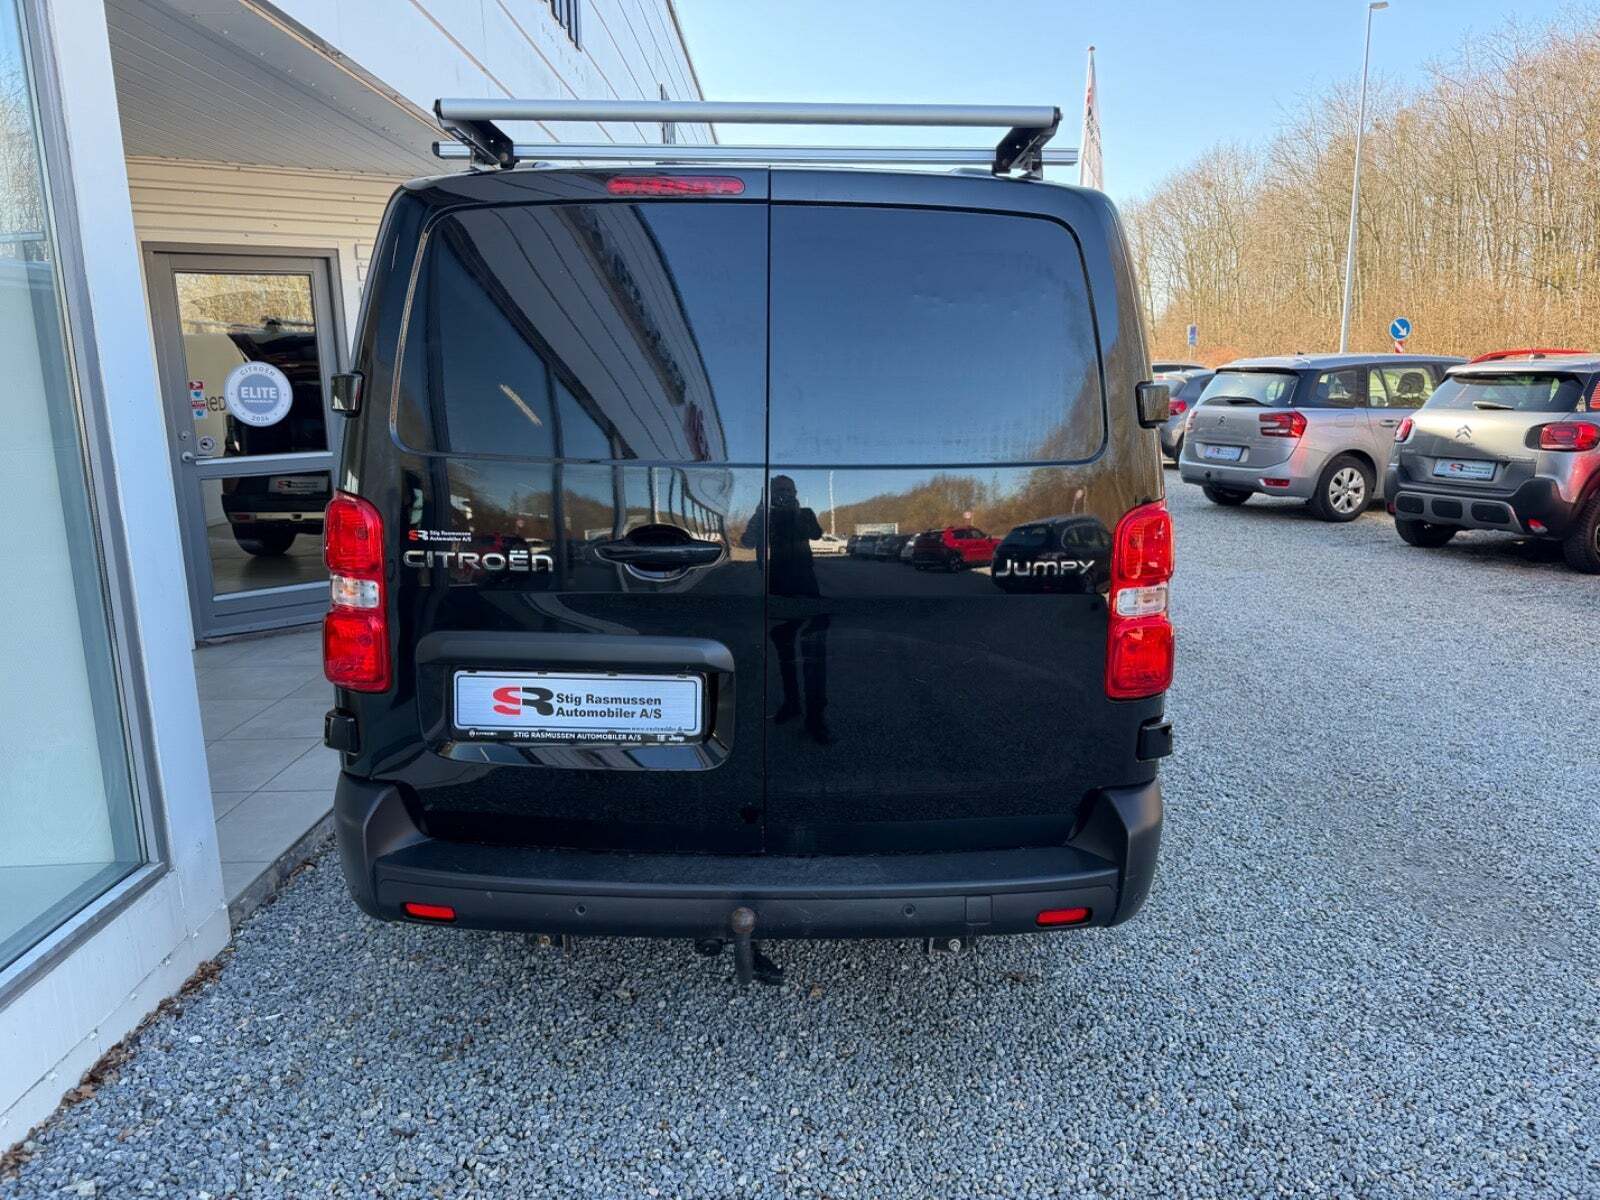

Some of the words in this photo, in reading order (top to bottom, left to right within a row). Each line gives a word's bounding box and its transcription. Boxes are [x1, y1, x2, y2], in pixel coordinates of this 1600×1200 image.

[240, 386, 278, 399] ELITE
[556, 692, 582, 706] Stig
[585, 693, 662, 706] Rasmussen
[555, 706, 636, 719] Automobiler
[640, 708, 662, 719] A/S
[530, 731, 575, 740] RASMUSSEN
[576, 732, 627, 741] AUTOMOBILER
[628, 733, 642, 741] A/S
